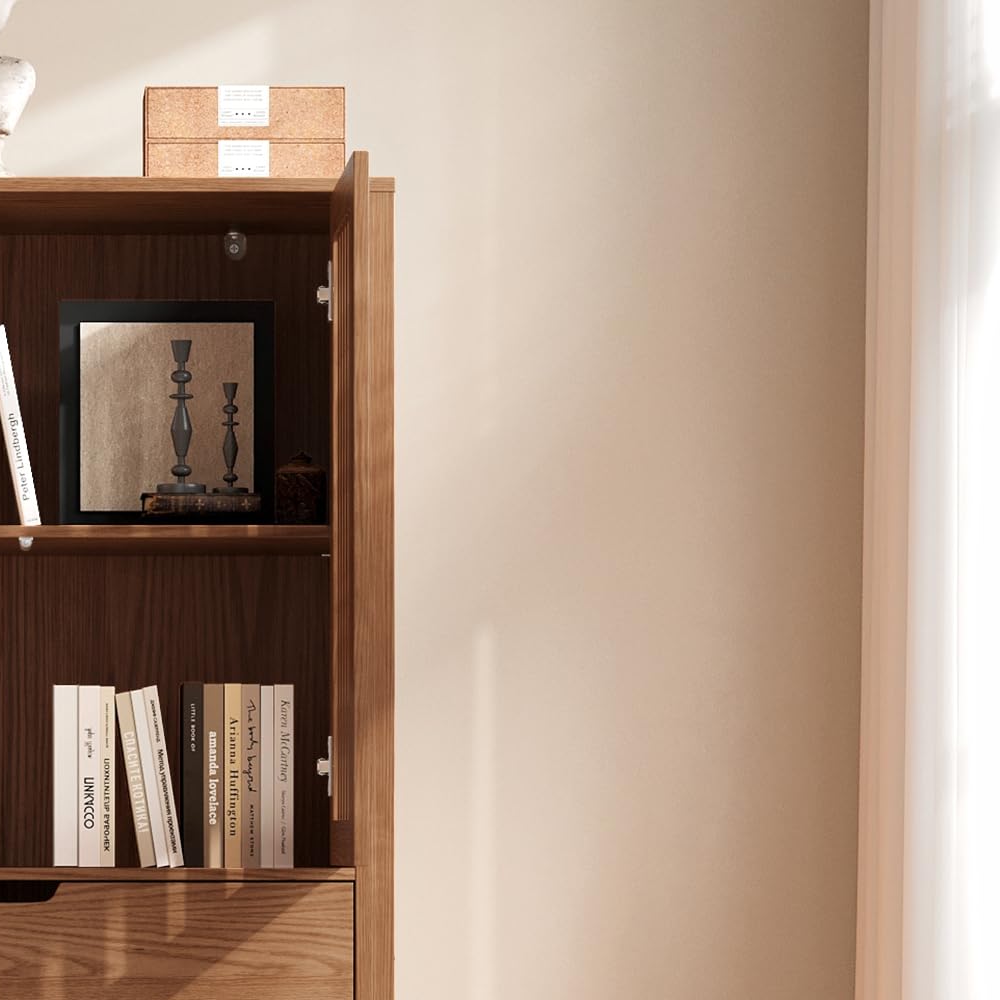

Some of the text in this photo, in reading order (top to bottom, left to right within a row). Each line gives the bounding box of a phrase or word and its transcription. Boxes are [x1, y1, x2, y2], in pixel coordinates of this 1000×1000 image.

[8, 413, 30, 501] Peter Lindbergh
[190, 743, 196, 752] OF
[247, 700, 256, 726] The
[277, 700, 291, 782] Karen McCartney
[209, 731, 219, 825] amanda lovelace
[227, 717, 239, 836] Arianna Huffington
